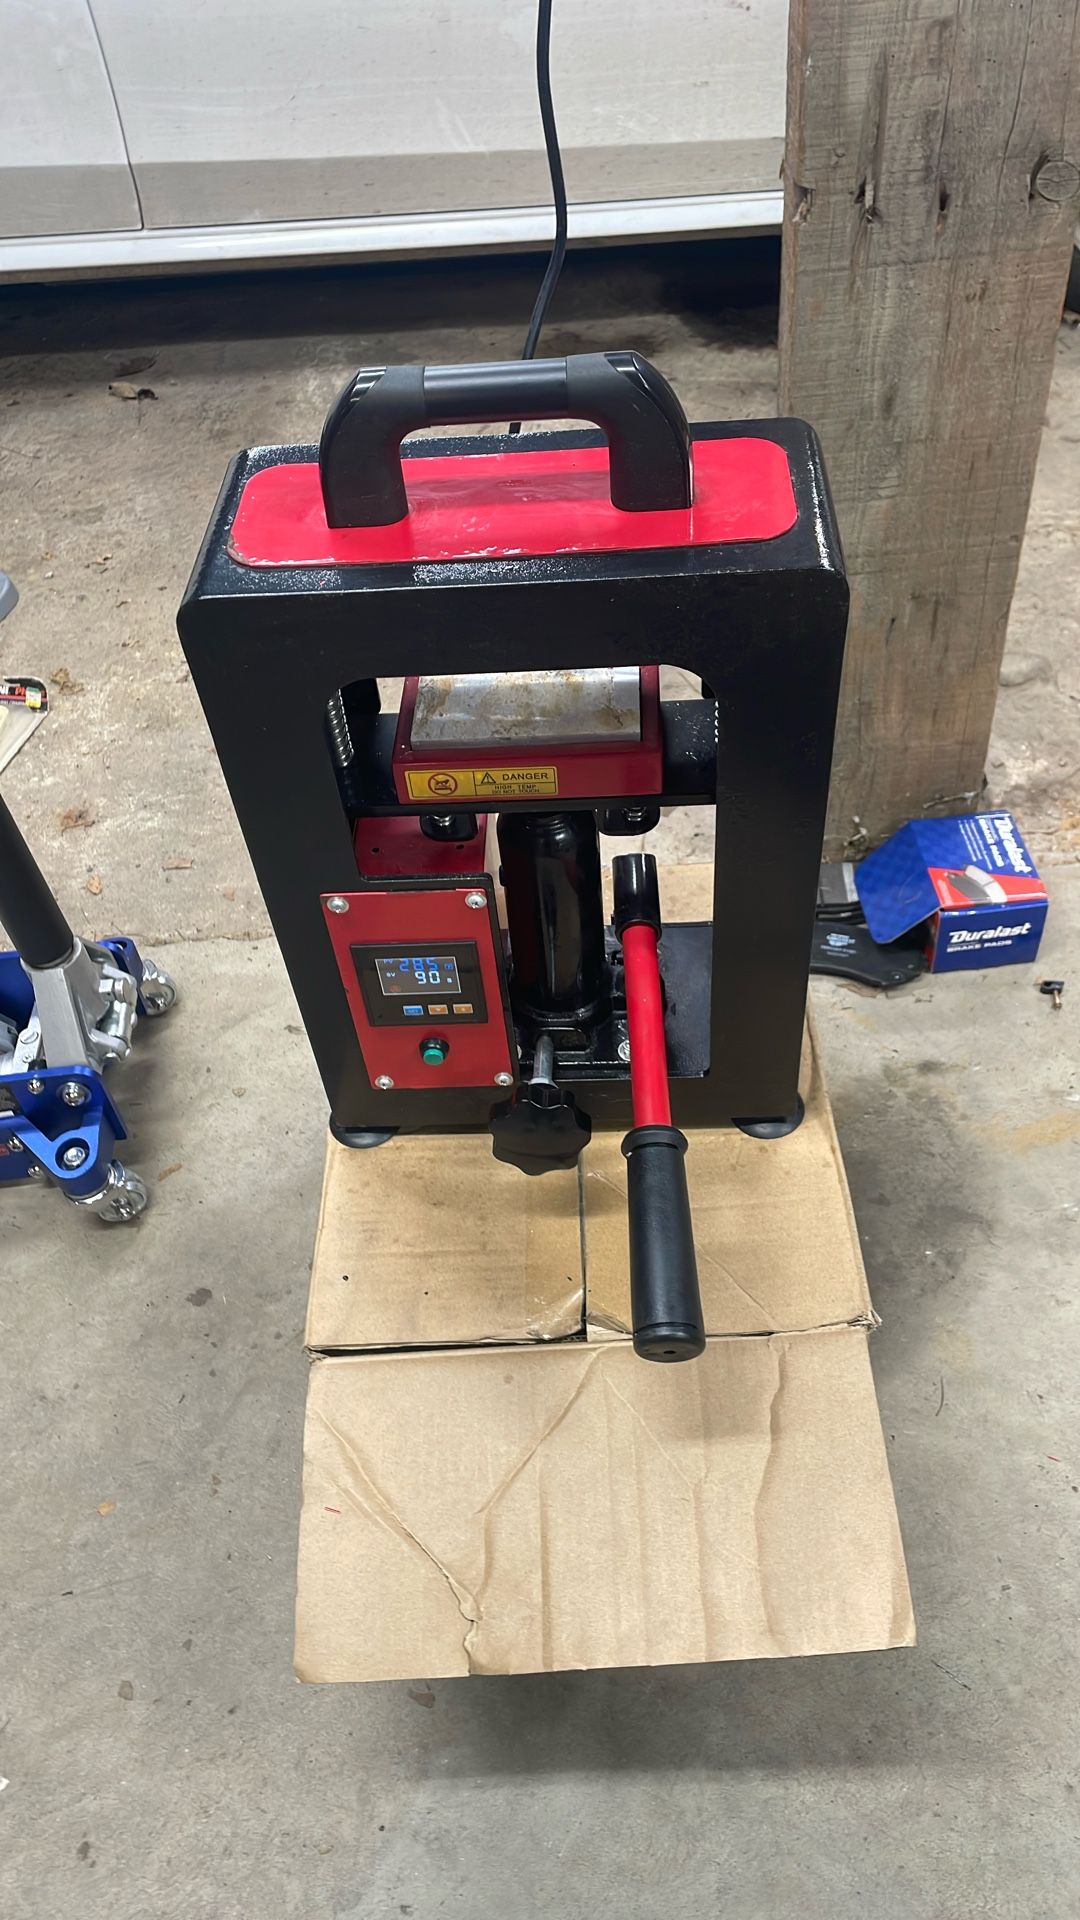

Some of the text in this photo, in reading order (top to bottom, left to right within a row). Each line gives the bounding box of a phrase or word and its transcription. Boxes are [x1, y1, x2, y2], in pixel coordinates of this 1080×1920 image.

[502, 772, 548, 781] DANGER
[979, 818, 995, 844] BRAKE
[990, 845, 1004, 867] PADS
[994, 816, 1032, 873] Duralast
[949, 922, 1032, 943] Duralast
[946, 940, 1012, 952] BRAKE PADS
[399, 958, 439, 972] 285
[414, 971, 440, 984] 90
